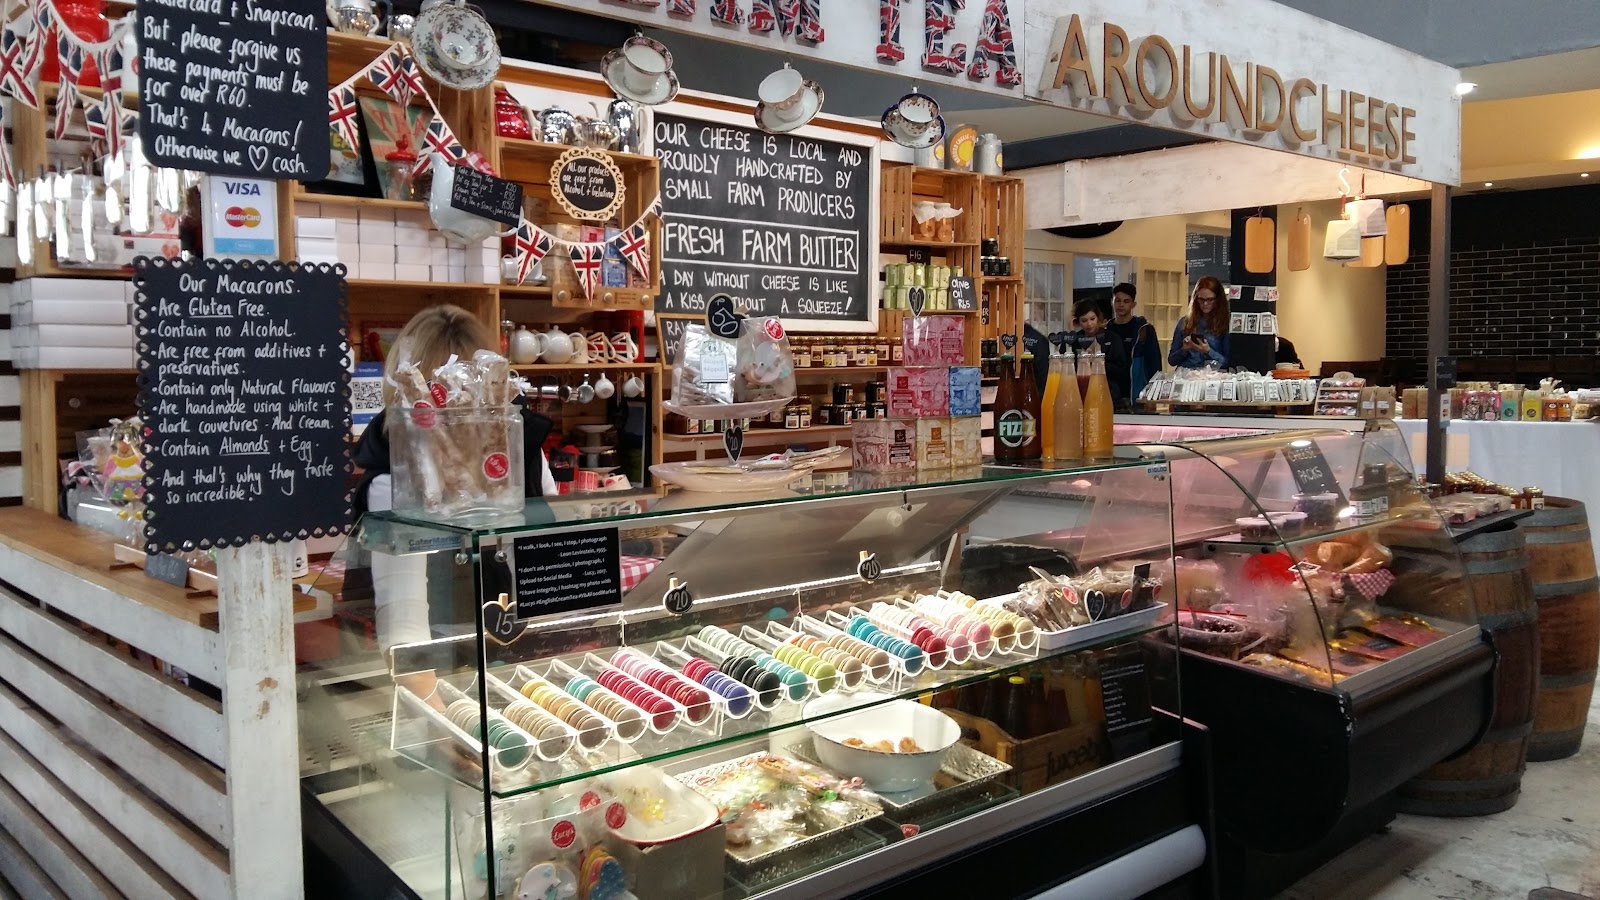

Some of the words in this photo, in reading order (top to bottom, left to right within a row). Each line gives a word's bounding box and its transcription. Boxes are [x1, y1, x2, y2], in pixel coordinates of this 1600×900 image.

[145, 0, 221, 15] astercard
[143, 16, 170, 41] But
[181, 24, 222, 53] please
[228, 38, 279, 72] forgive
[286, 46, 302, 66] us
[143, 47, 177, 73] these
[185, 61, 249, 92] payments
[255, 70, 285, 92] must
[291, 71, 309, 96] be
[144, 77, 172, 101] for
[180, 84, 210, 104] over
[148, 102, 190, 131] That's
[201, 111, 213, 135] 4
[222, 117, 304, 151] Macarons!
[154, 134, 219, 164] Otherwise
[223, 149, 242, 166] we
[272, 152, 309, 174] cash.
[654, 121, 690, 148] OUR
[699, 126, 751, 153] CHEESE
[763, 135, 778, 156] IS
[789, 138, 827, 162] LOCAL
[838, 147, 862, 168] AND
[577, 165, 588, 174] our
[588, 164, 610, 178] products
[655, 149, 721, 176] PROUDLY
[735, 156, 824, 185] HANDCRAFTED
[835, 170, 853, 190] BY
[222, 181, 261, 196] VISA
[574, 175, 587, 186] free
[589, 177, 604, 188] from
[592, 185, 615, 200] Gelatine
[665, 178, 713, 201] SMALL
[727, 181, 765, 208] FARM
[778, 186, 856, 220] PRODUCERS
[225, 213, 261, 221] MasterCard
[665, 222, 725, 256] FRESH
[742, 228, 792, 265] FARM
[799, 233, 858, 270] BUTTER
[909, 248, 922, 260] FIG
[179, 273, 207, 293] Our
[216, 274, 301, 295] Macarons.
[674, 269, 695, 287] DAY
[704, 271, 751, 291] WITHOUT
[761, 274, 801, 292] CHEESE
[808, 276, 821, 292] IS
[825, 279, 849, 294] LIKE
[951, 278, 970, 290] Olive
[158, 298, 182, 317] Are
[189, 297, 234, 318] Gluten
[238, 298, 270, 317] Free.
[665, 292, 674, 309] A
[680, 291, 706, 311] KISS
[780, 298, 790, 314] A
[798, 296, 853, 316] SQUEEZE!
[157, 320, 207, 338] Contain
[215, 324, 232, 337] no
[240, 319, 297, 338] Alcohol.
[157, 341, 179, 360] Are
[183, 343, 211, 366] free
[214, 343, 246, 365] from
[254, 341, 312, 358] additives
[158, 360, 246, 381] preservatives.
[158, 379, 205, 397] Contain
[210, 380, 235, 399] only
[240, 379, 286, 397] Natural
[291, 379, 336, 396] Flavours
[158, 400, 179, 416] Are
[185, 398, 247, 415] handmade
[253, 400, 283, 419] using
[288, 397, 319, 413] white
[158, 417, 190, 434] dark
[198, 415, 259, 434] couvetures
[271, 414, 294, 431] And
[298, 416, 334, 430] Cream.
[161, 438, 210, 457] Contain
[219, 434, 271, 456] Almonds
[1288, 447, 1317, 462] CHEESE
[236, 464, 262, 496] why
[268, 461, 295, 497] they
[304, 456, 334, 479] taste
[1298, 465, 1324, 486] PACKS
[165, 489, 180, 505] so
[581, 535, 607, 545] photograph
[519, 577, 537, 586] Upload
[543, 574, 558, 582] Social
[586, 580, 600, 588] photo
